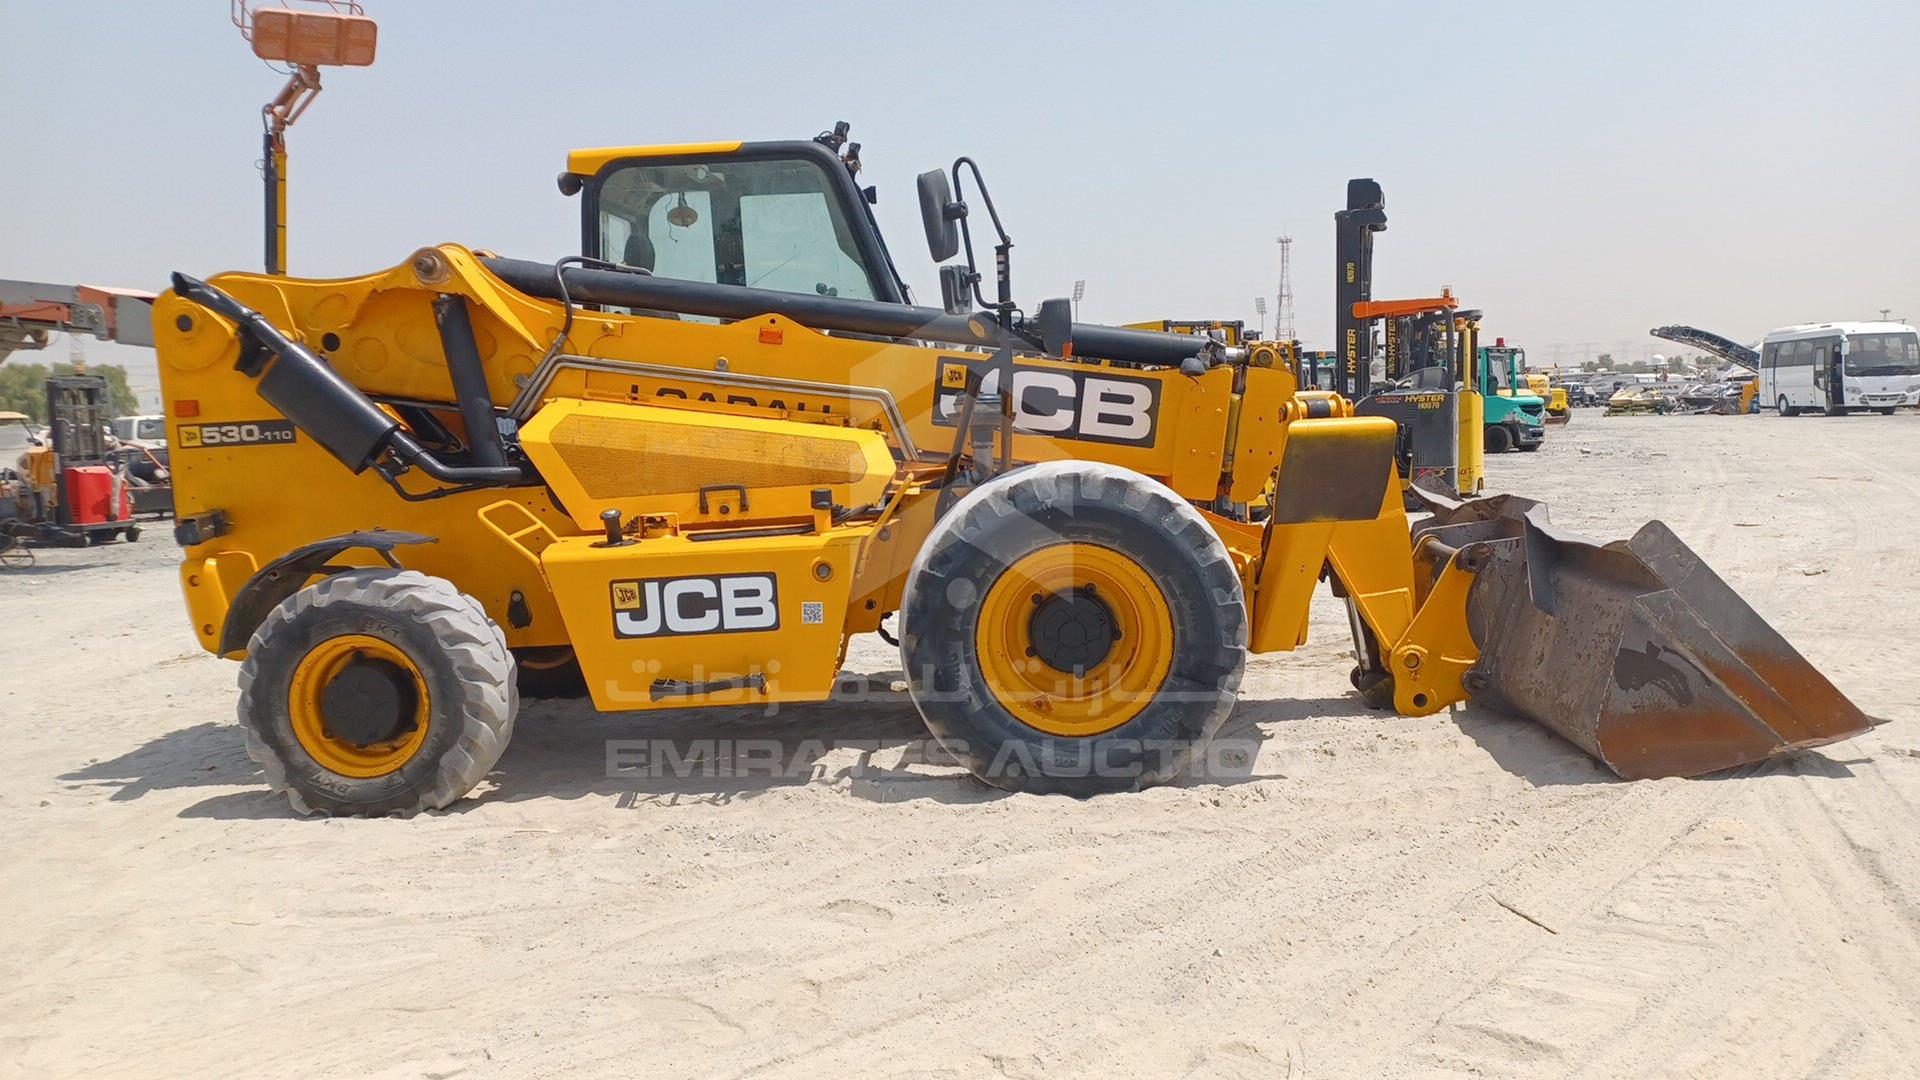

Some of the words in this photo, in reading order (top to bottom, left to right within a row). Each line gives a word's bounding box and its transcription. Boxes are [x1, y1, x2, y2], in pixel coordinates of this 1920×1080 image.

[1347, 328, 1356, 374] HYSTER
[1404, 394, 1445, 403] HYSTER
[616, 586, 637, 602] JCB
[616, 576, 776, 635] JCB
